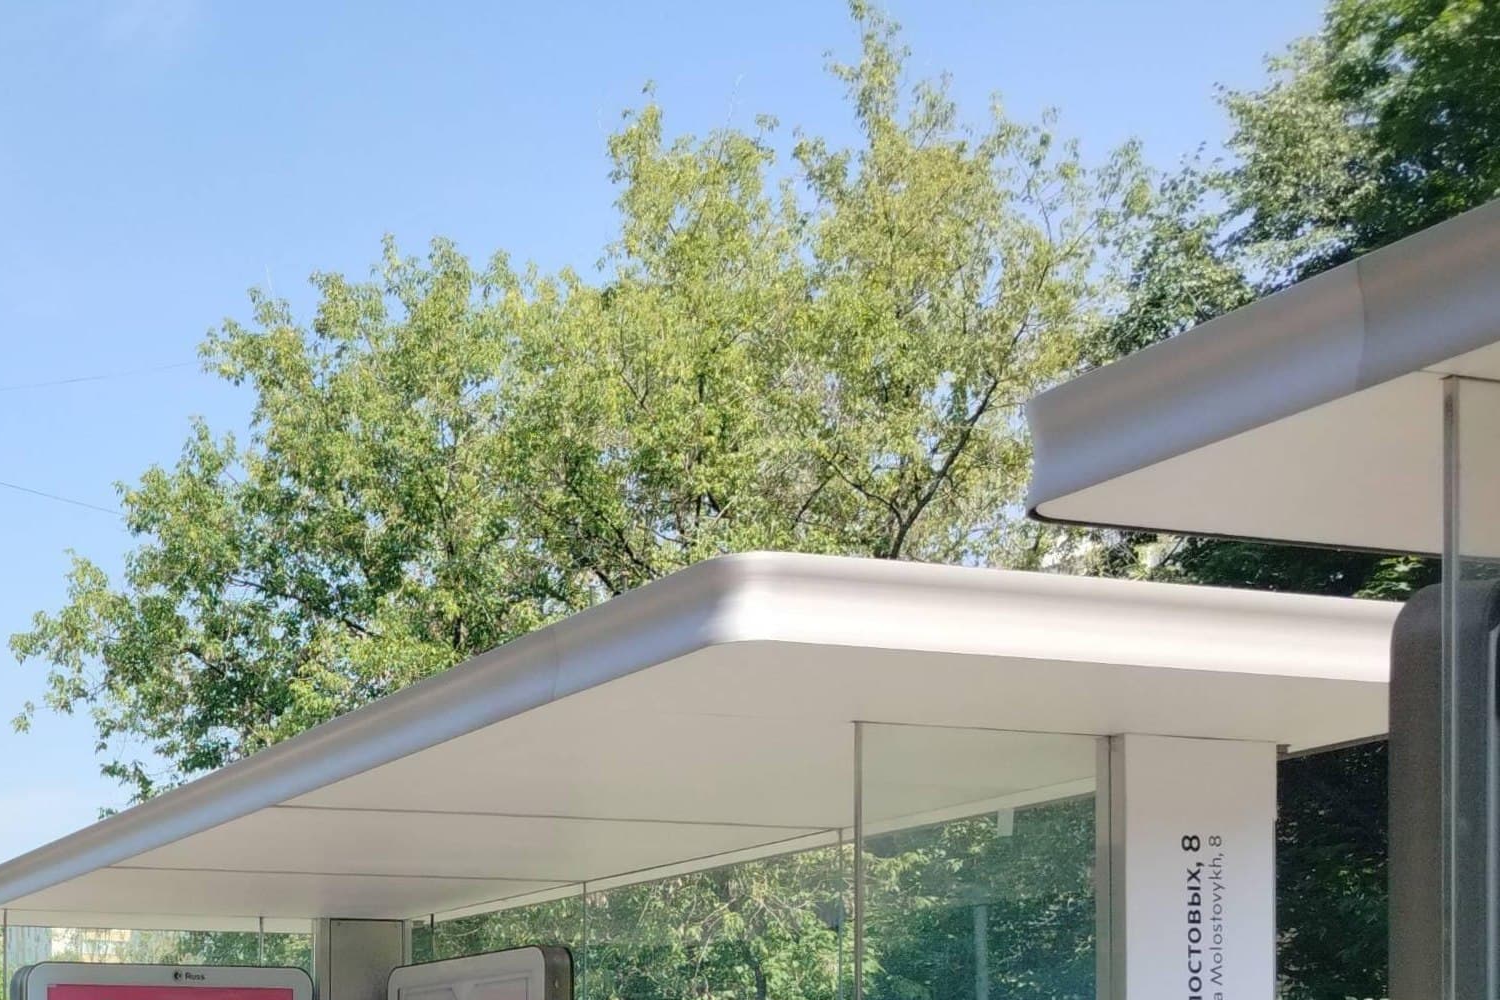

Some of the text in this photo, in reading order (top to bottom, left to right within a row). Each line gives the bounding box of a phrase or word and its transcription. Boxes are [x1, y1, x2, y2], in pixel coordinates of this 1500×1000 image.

[1181, 835, 1201, 852] 8
[1208, 835, 1222, 847] 8
[1208, 853, 1225, 986] Molostovykh,
